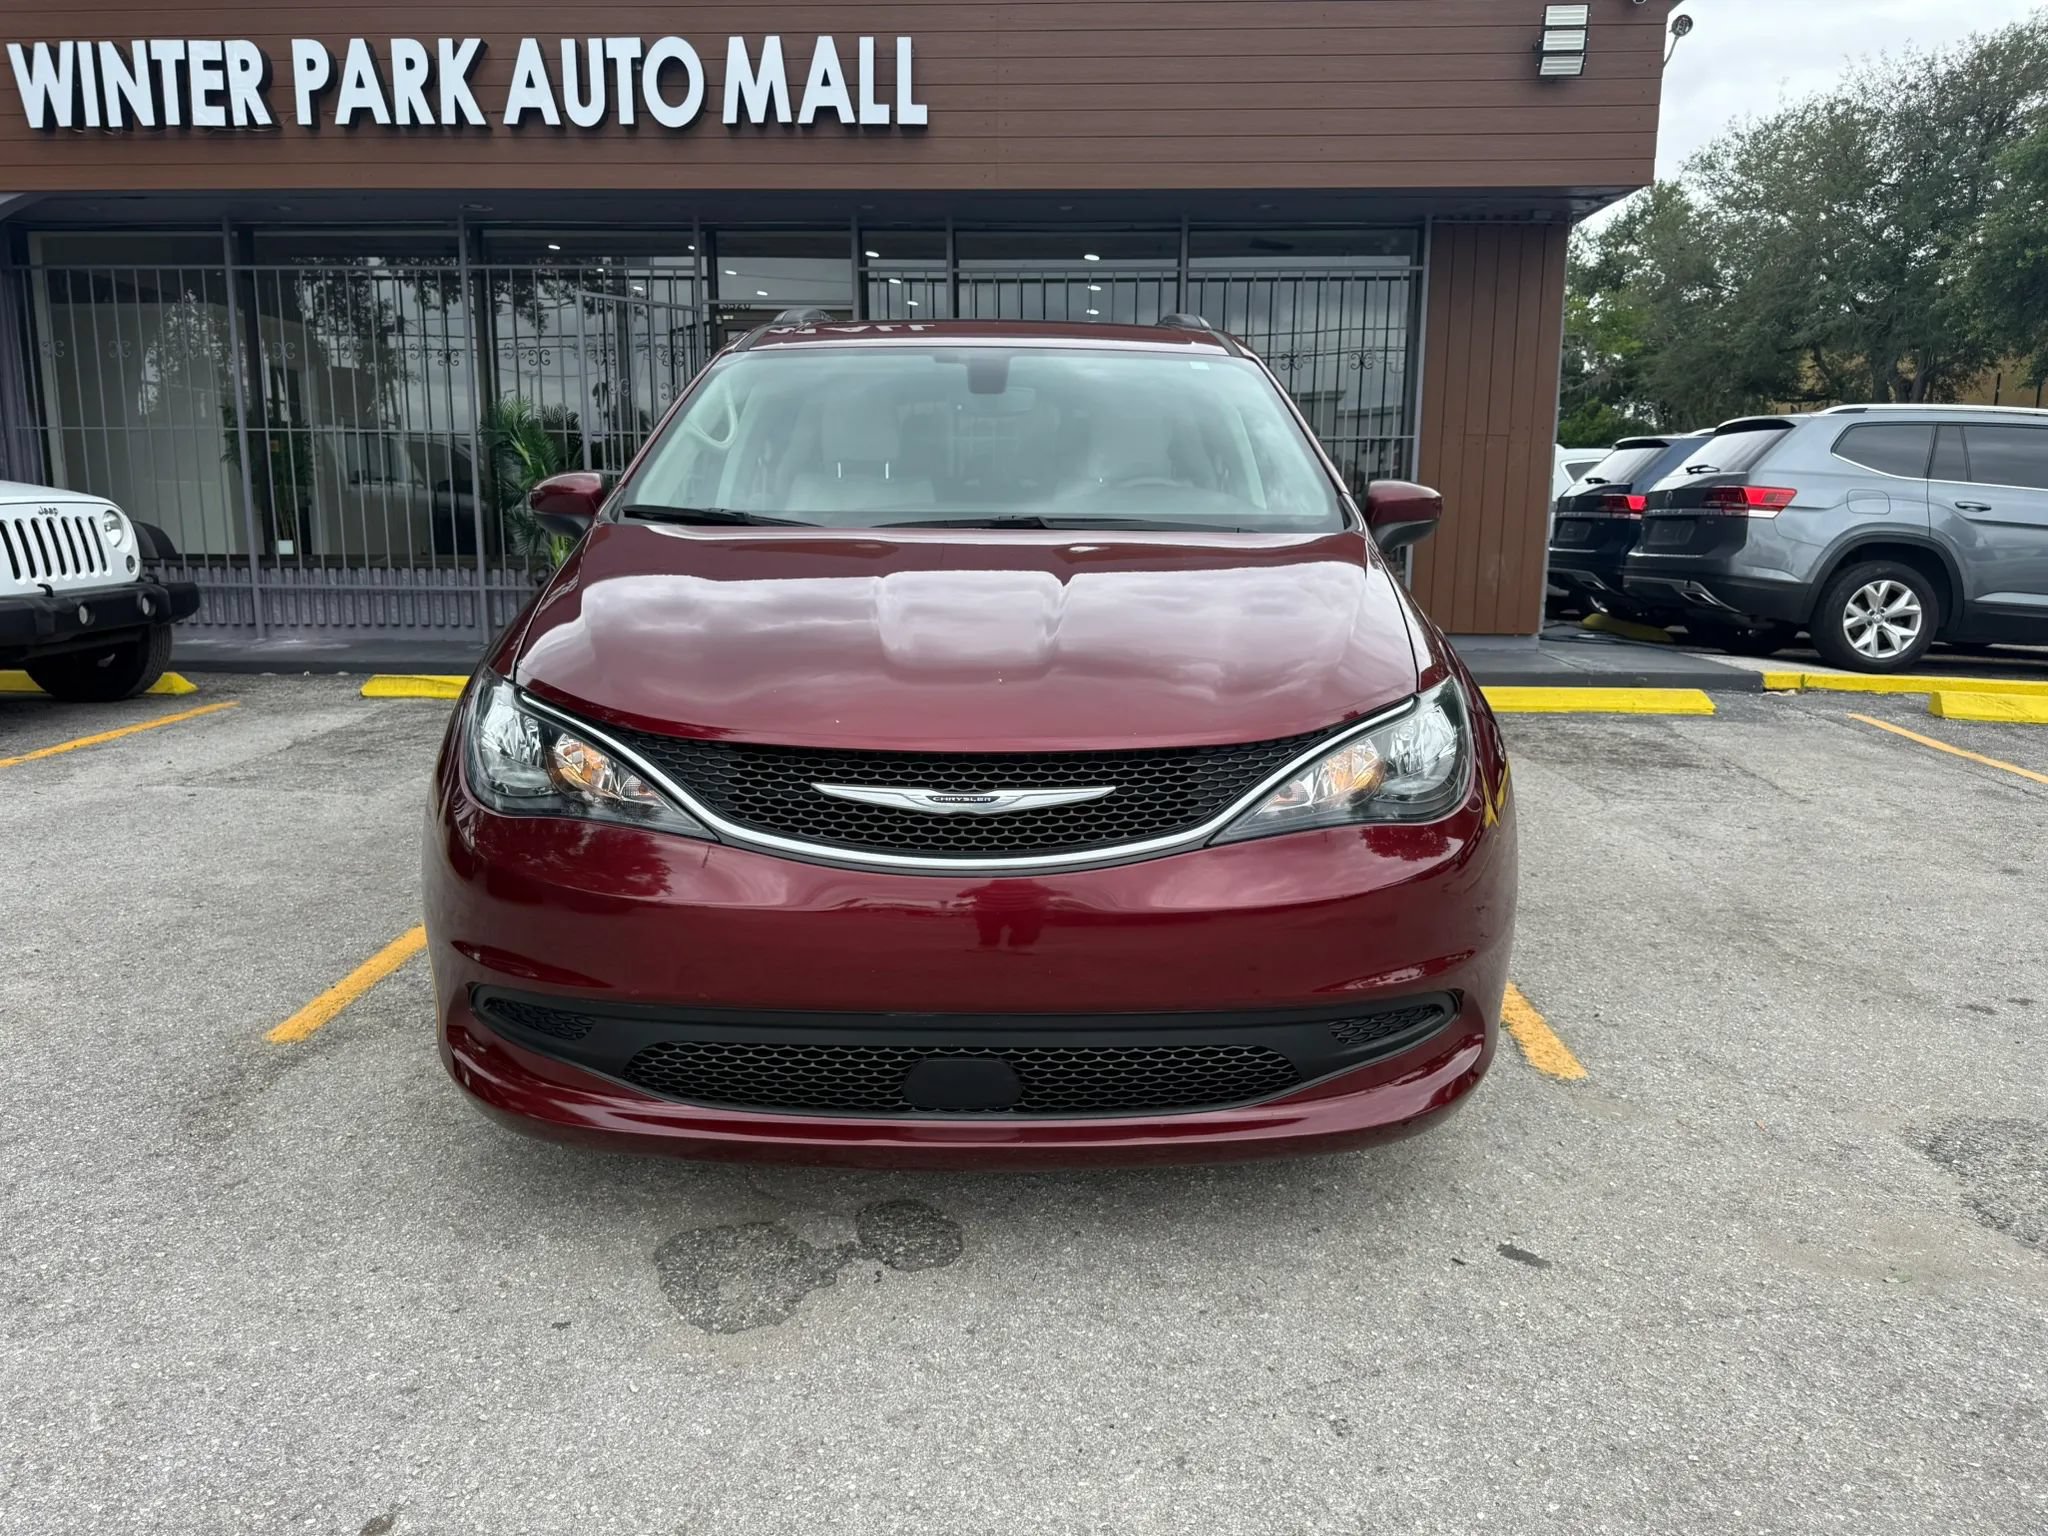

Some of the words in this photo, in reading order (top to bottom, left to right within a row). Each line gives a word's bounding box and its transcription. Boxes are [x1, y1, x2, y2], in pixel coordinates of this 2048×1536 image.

[6, 39, 273, 129] WINTER
[291, 37, 488, 126] PARK
[502, 35, 705, 128] AUTO
[722, 35, 929, 125] MALL
[38, 505, 58, 516] Jeep
